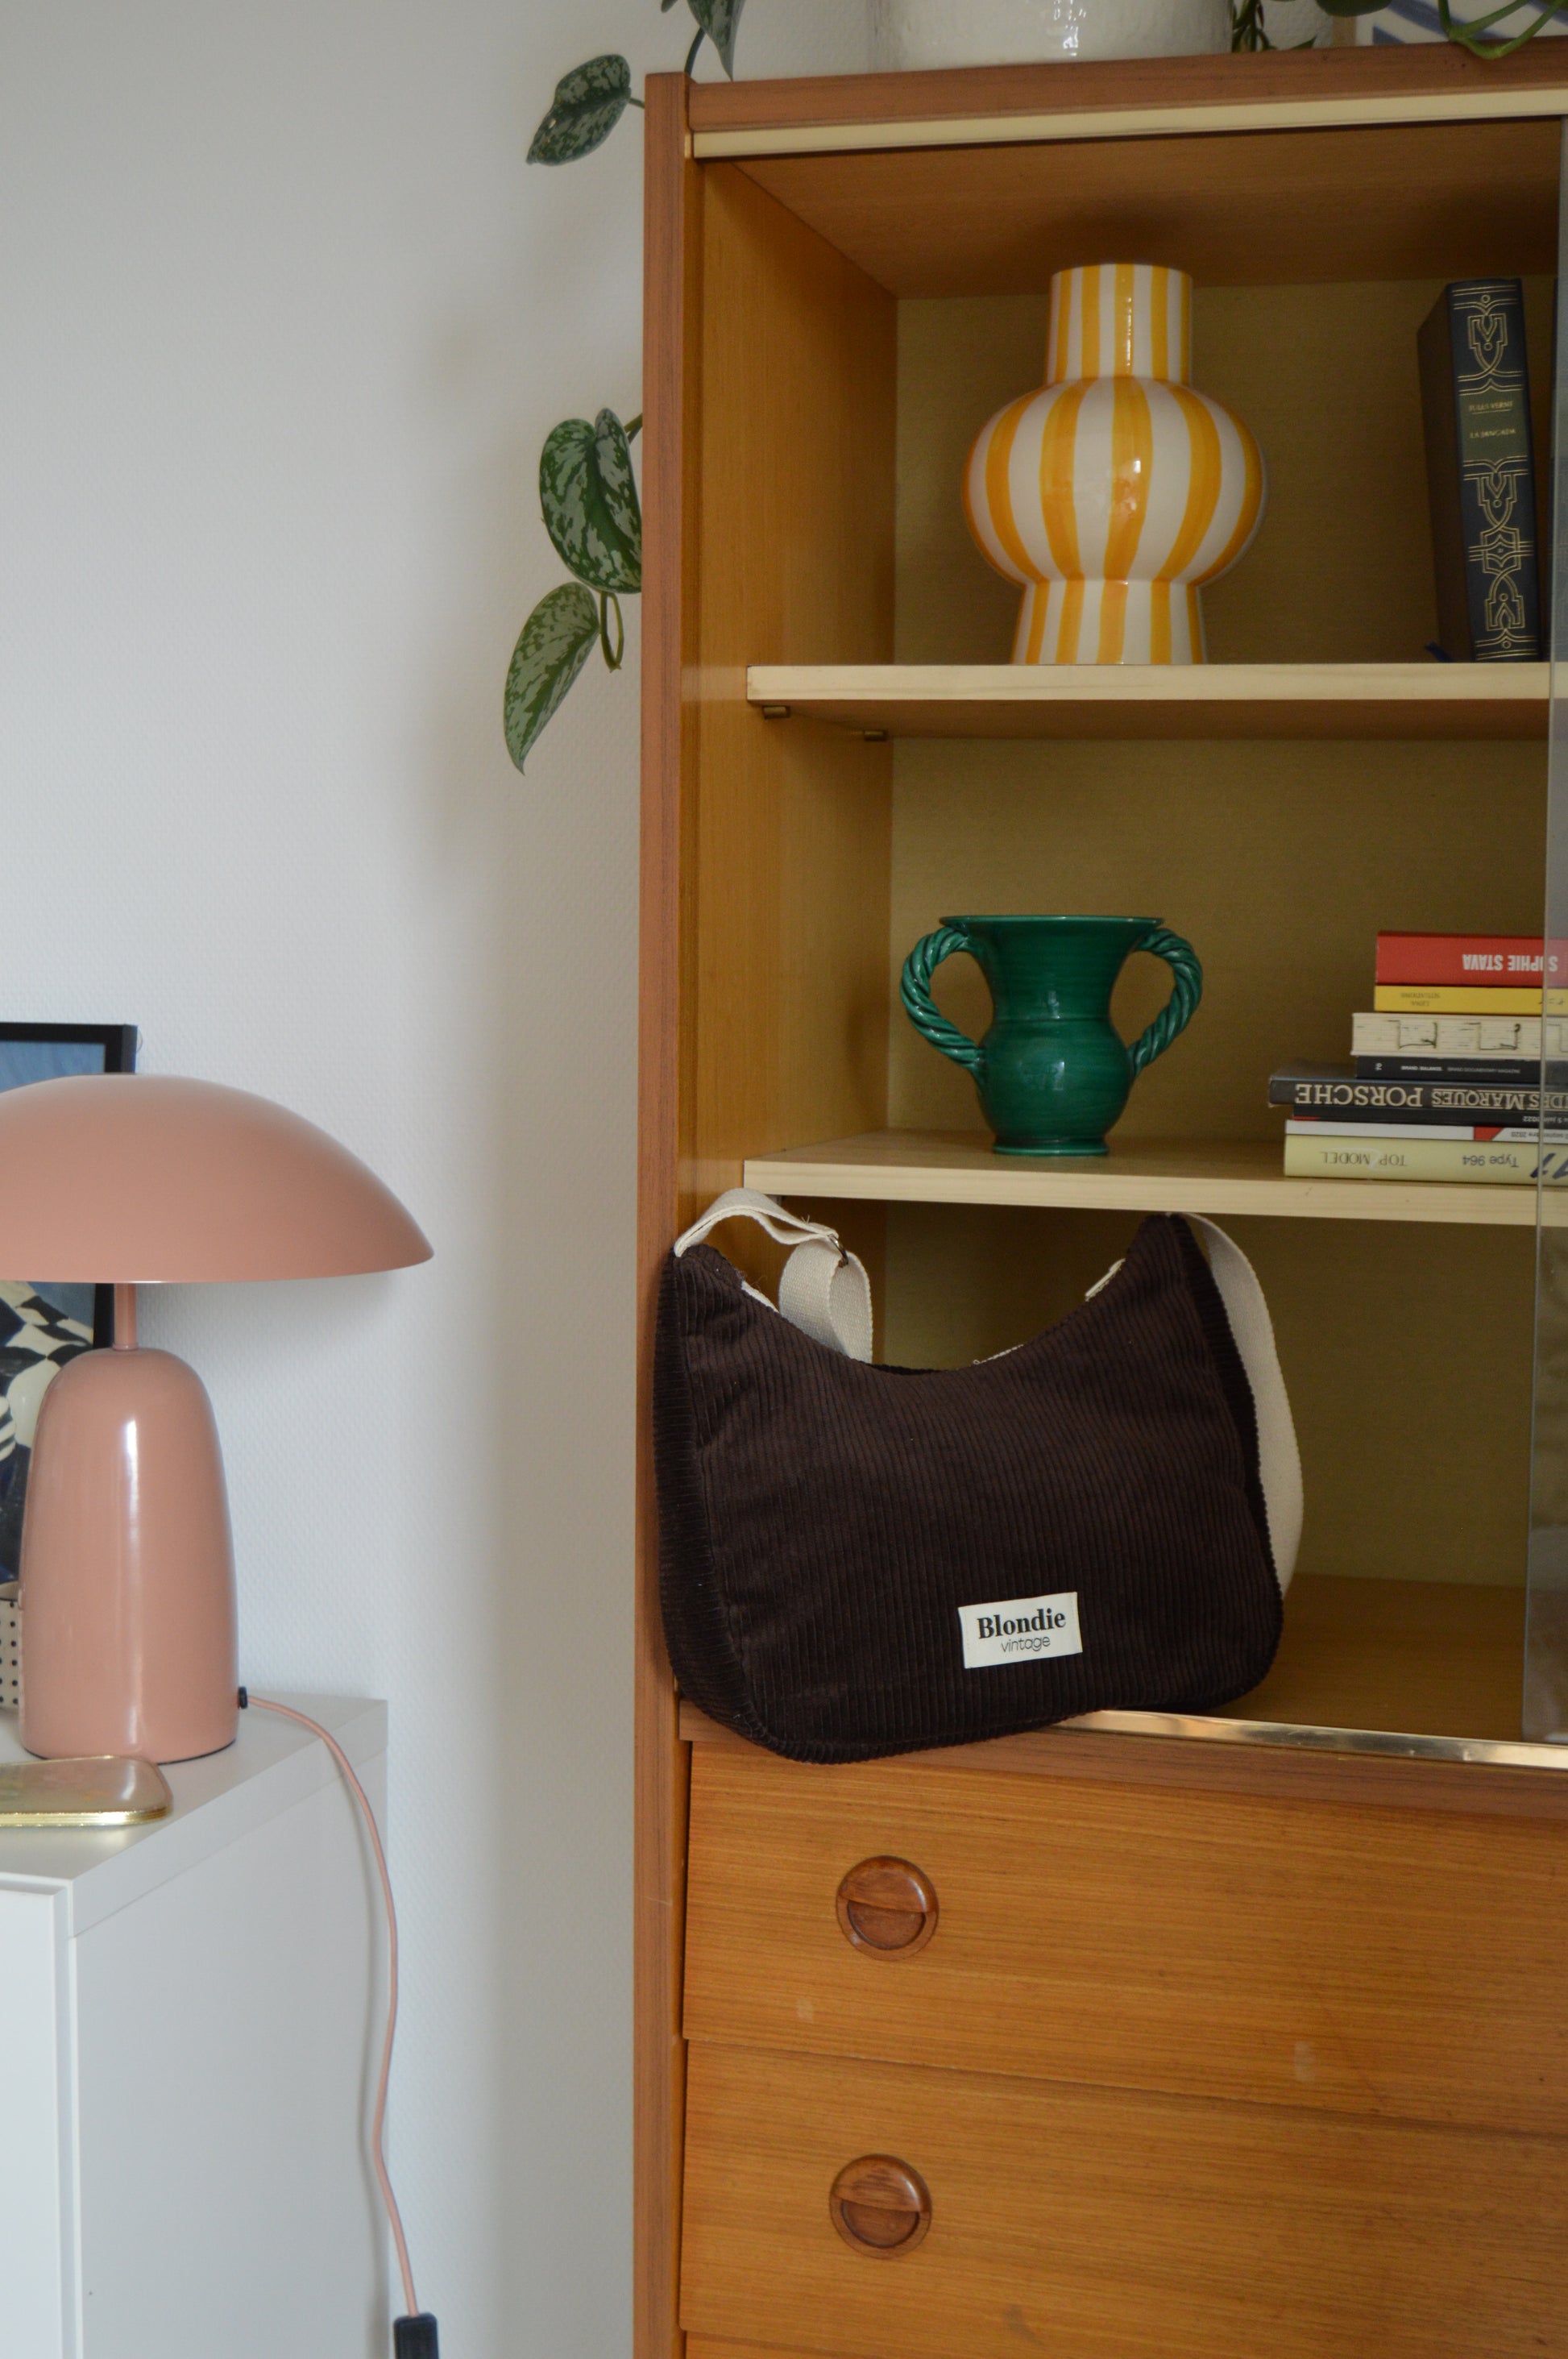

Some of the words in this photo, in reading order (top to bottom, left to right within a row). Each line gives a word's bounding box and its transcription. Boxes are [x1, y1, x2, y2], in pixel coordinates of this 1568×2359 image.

[1462, 954, 1504, 971] STAVA
[1295, 1083, 1424, 1107] PORSCHE
[1433, 1089, 1525, 1110] MARQUES
[1319, 1151, 1371, 1165] MODEL
[1379, 1154, 1407, 1167] TOP
[1462, 1154, 1486, 1165] 964
[1490, 1154, 1519, 1168] Type
[977, 1608, 1066, 1639] Blondie
[1002, 1636, 1051, 1653] vintage
